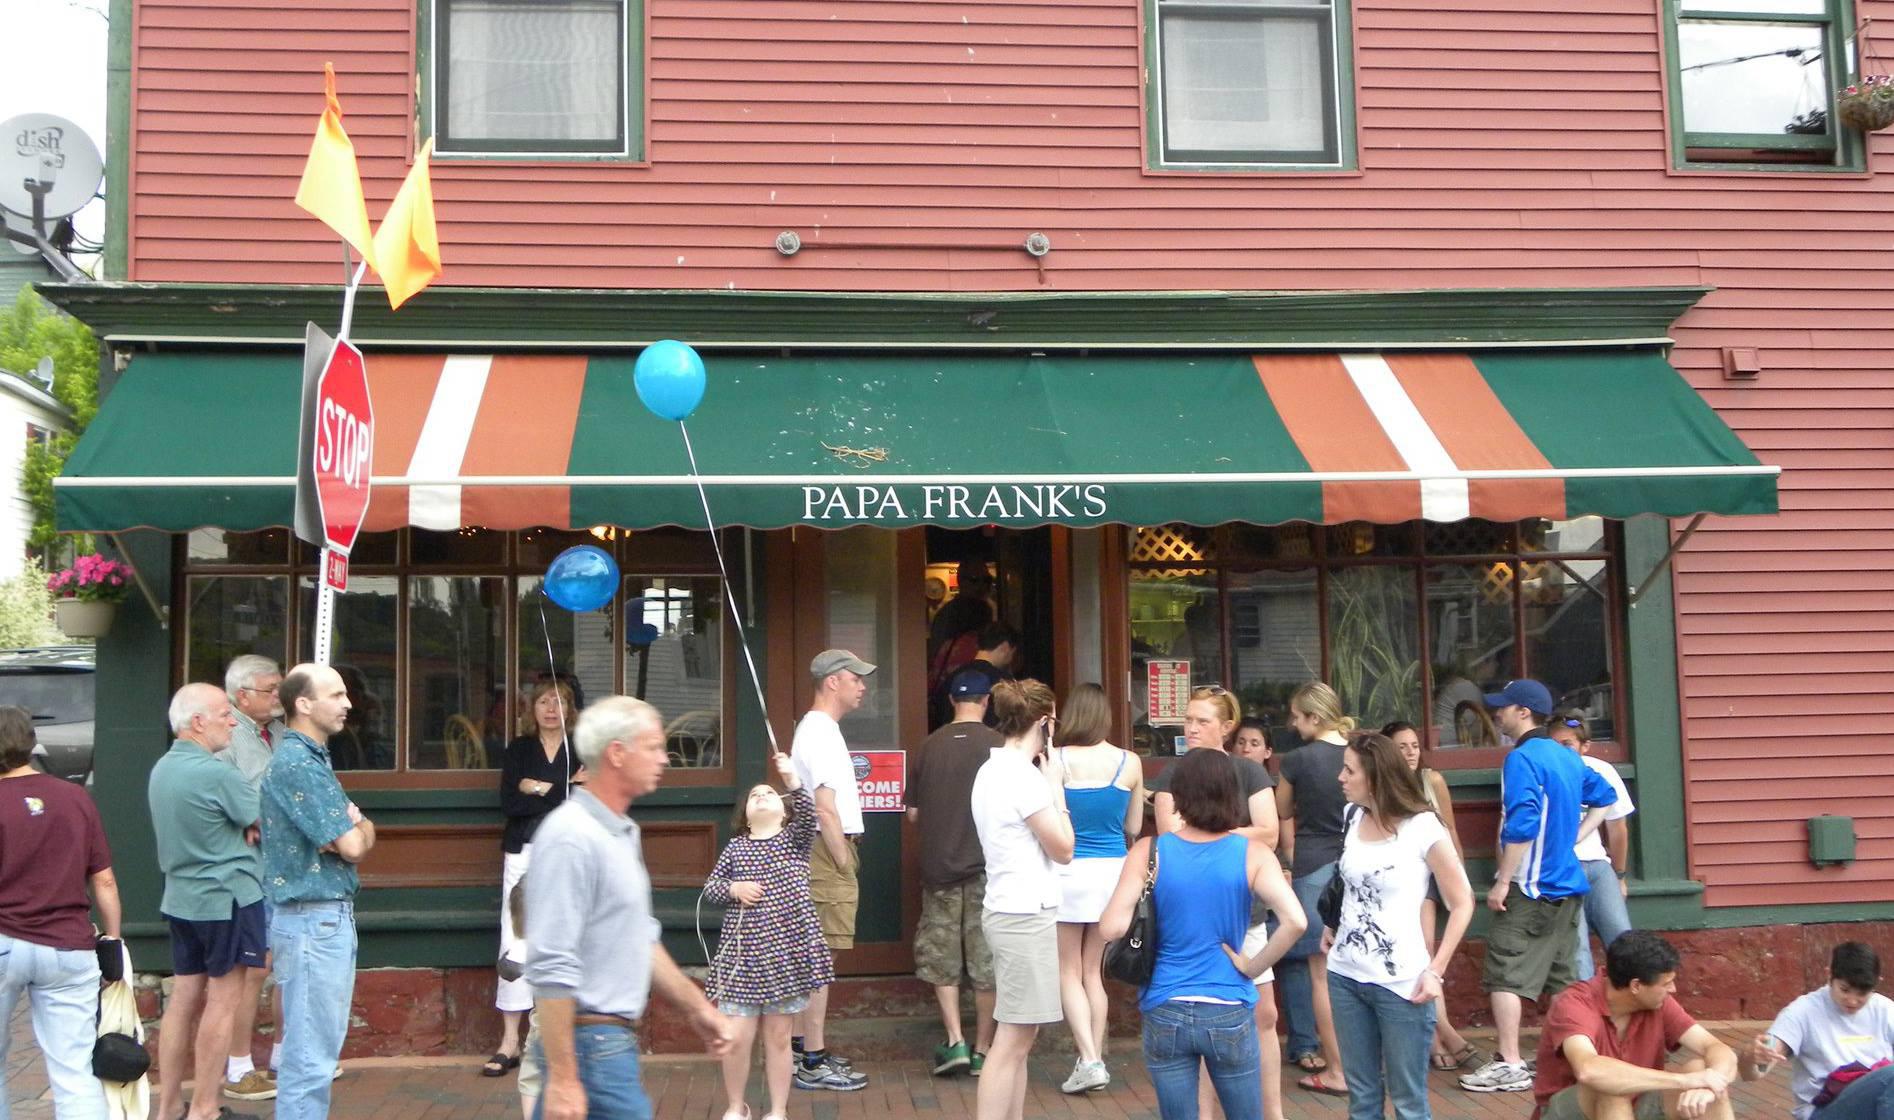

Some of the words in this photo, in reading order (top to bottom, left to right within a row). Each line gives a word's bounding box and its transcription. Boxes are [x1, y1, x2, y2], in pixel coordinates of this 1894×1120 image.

[16, 129, 60, 149] dish
[319, 397, 370, 489] STOP
[802, 486, 908, 519] PAPA
[922, 485, 1107, 518] FRANK'S
